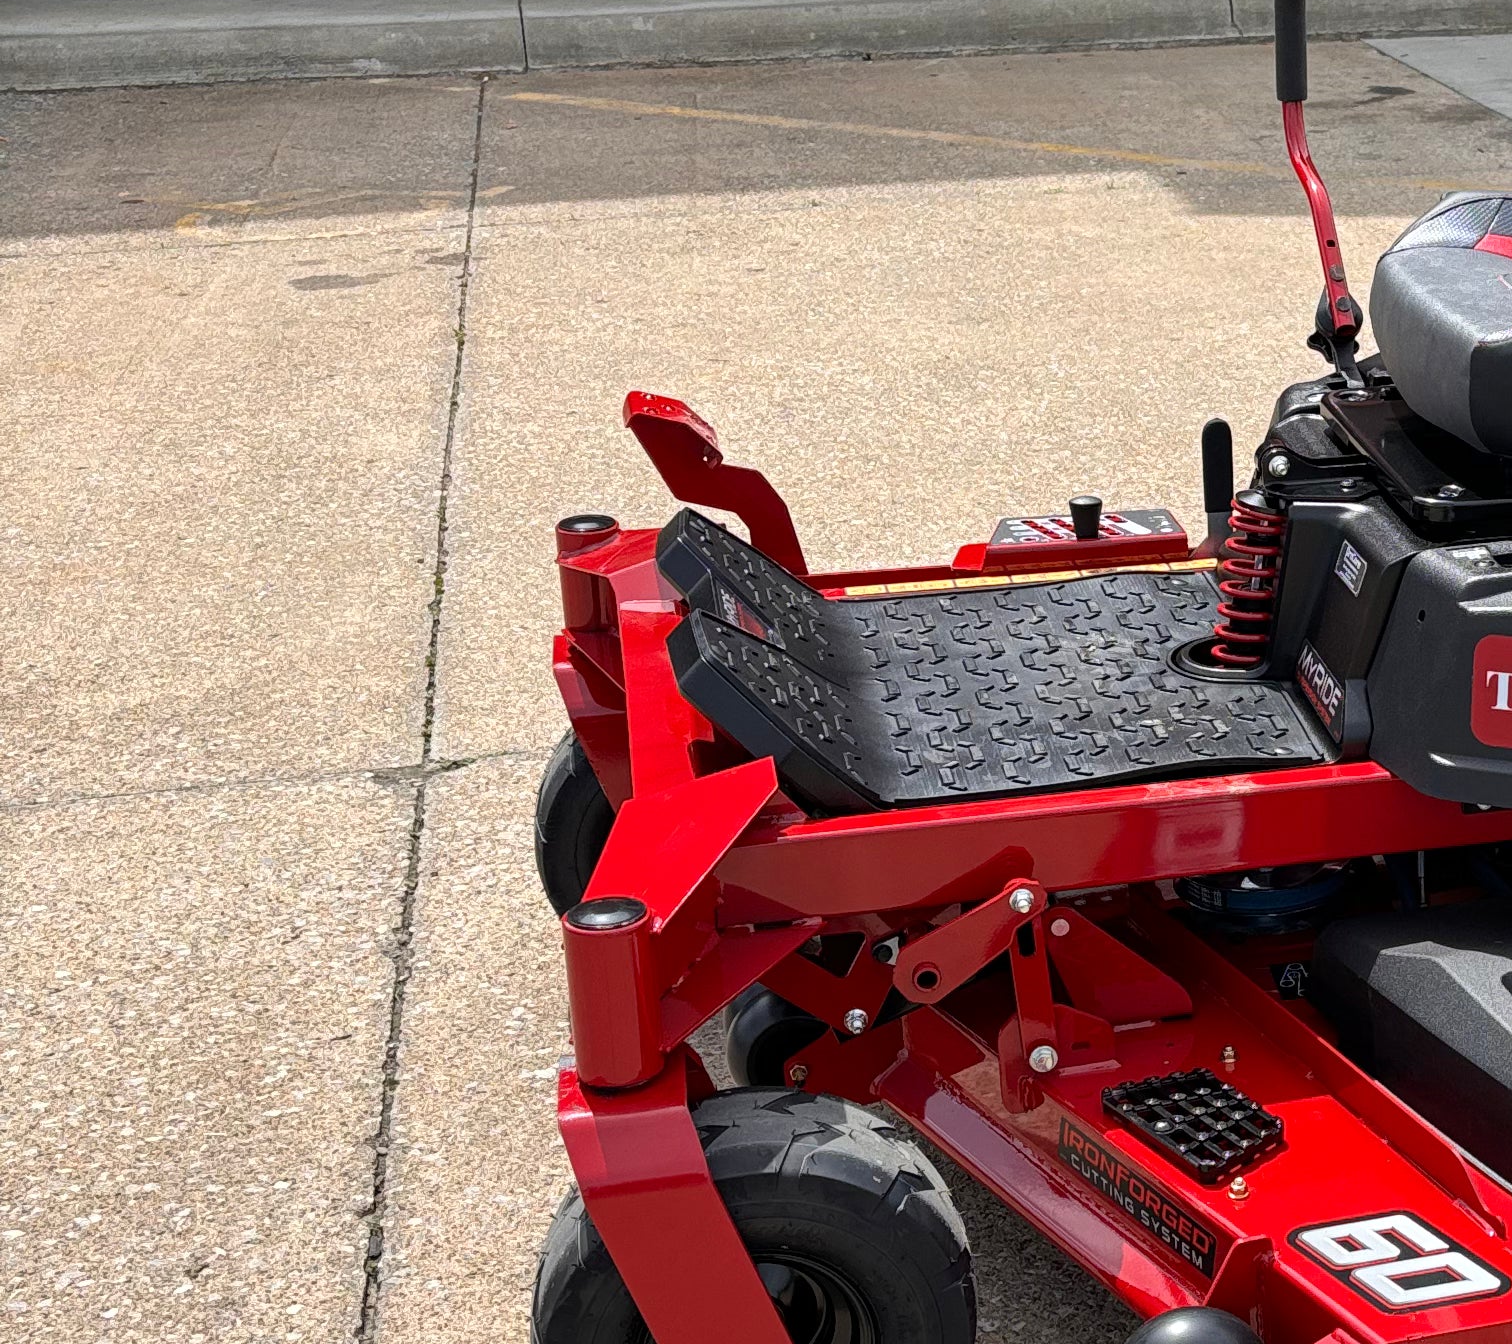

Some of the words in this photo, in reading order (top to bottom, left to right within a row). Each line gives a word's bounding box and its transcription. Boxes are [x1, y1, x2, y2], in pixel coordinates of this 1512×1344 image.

[1063, 1121, 1210, 1255] IRONFORGED
[1070, 1153, 1135, 1215] CUTTING
[1139, 1209, 1204, 1270] SYSTEM
[1296, 1214, 1501, 1310] 60
